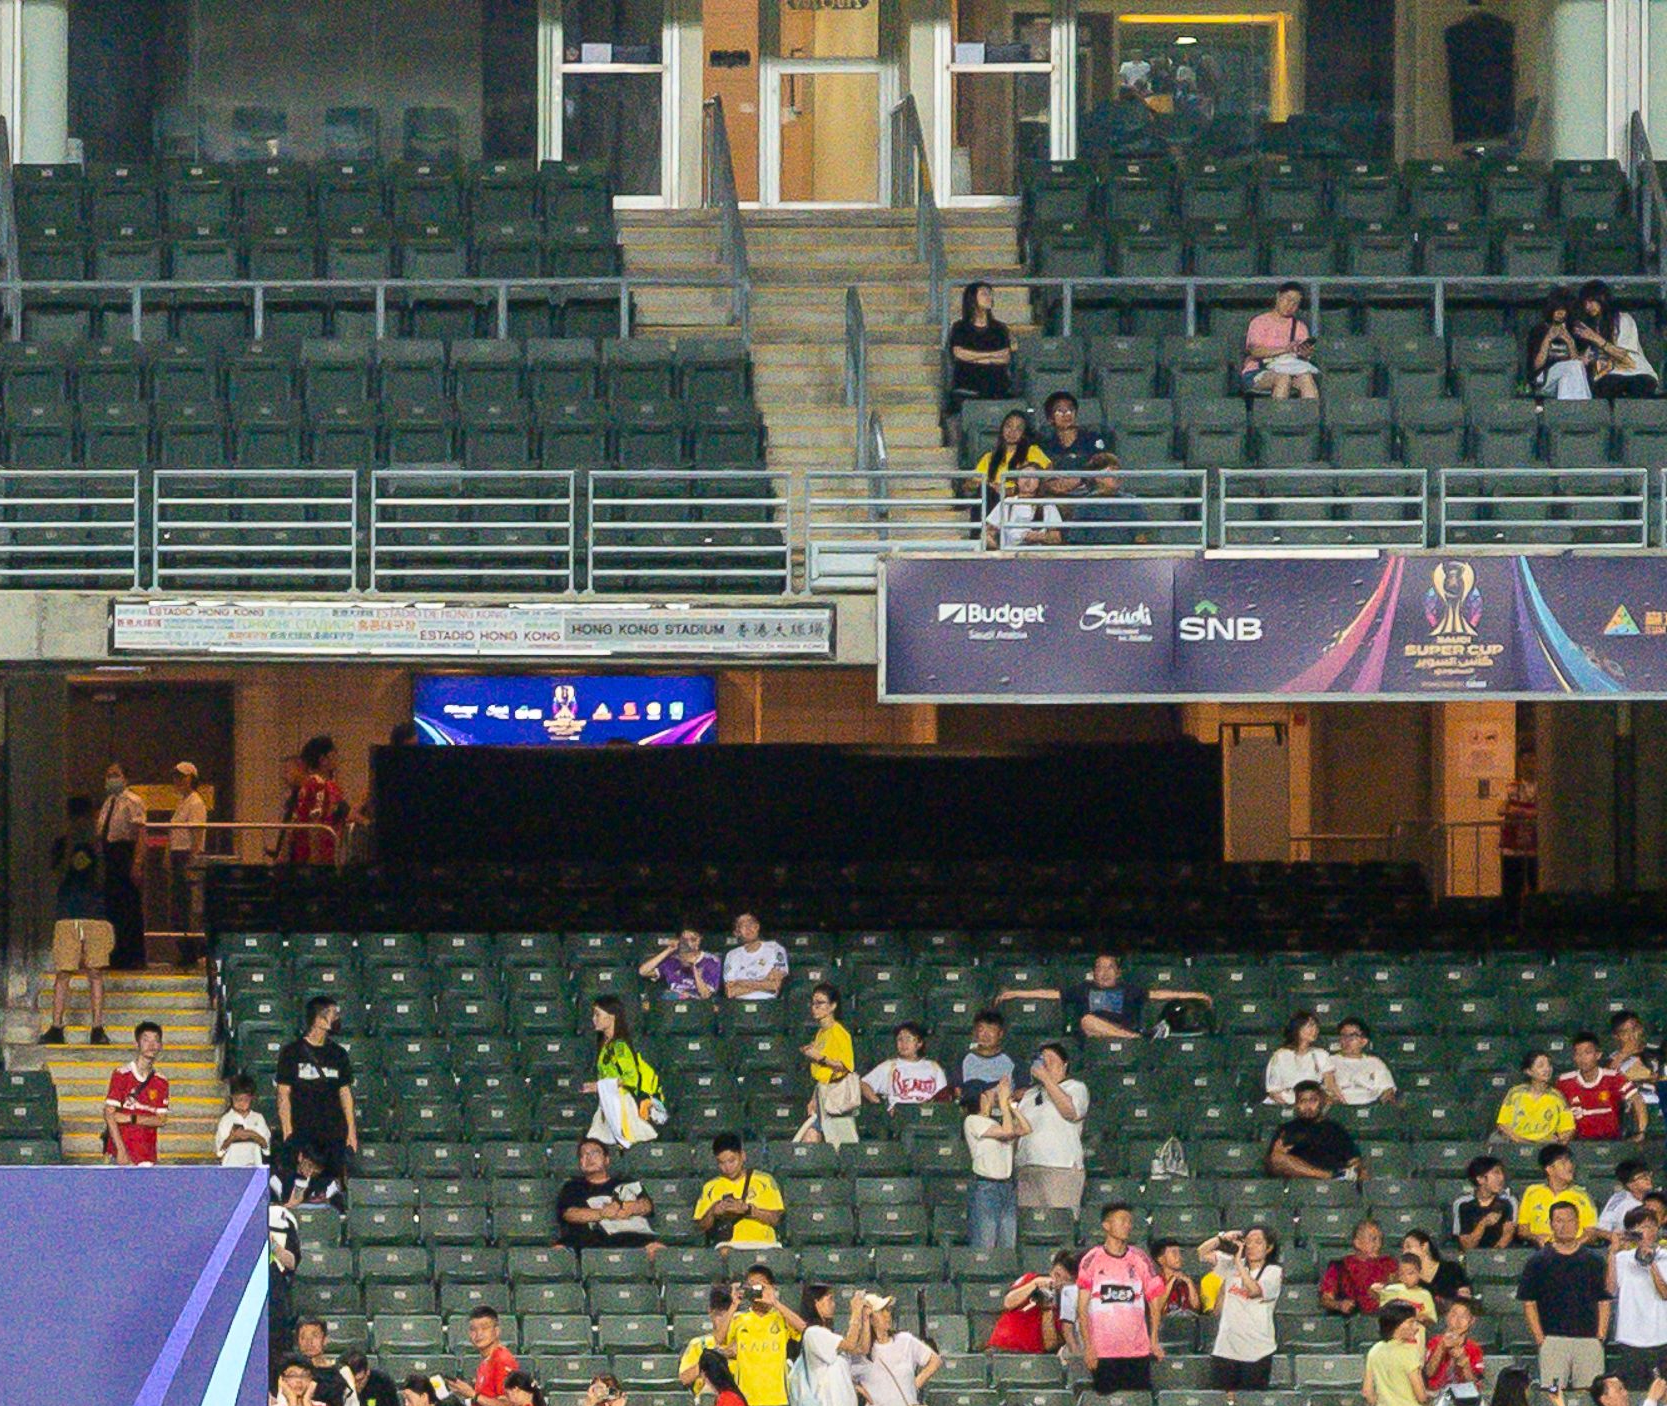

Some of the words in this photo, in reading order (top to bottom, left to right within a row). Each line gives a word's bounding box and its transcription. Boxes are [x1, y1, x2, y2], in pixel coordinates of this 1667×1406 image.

[148, 607, 194, 617] ESTADIO
[198, 607, 229, 617] HONG
[234, 607, 265, 617] KONG
[968, 603, 1045, 629] Budget
[1079, 601, 1152, 631] Saudi
[572, 623, 613, 635] HONG
[618, 623, 659, 635] KONG
[664, 623, 725, 635] STADIUM
[1179, 617, 1263, 641] SNB
[420, 630, 475, 641] ESTADIO
[479, 630, 518, 641] HONG
[523, 630, 561, 641] KONG
[1404, 644, 1464, 656] SUPER
[1466, 644, 1504, 656] CUP
